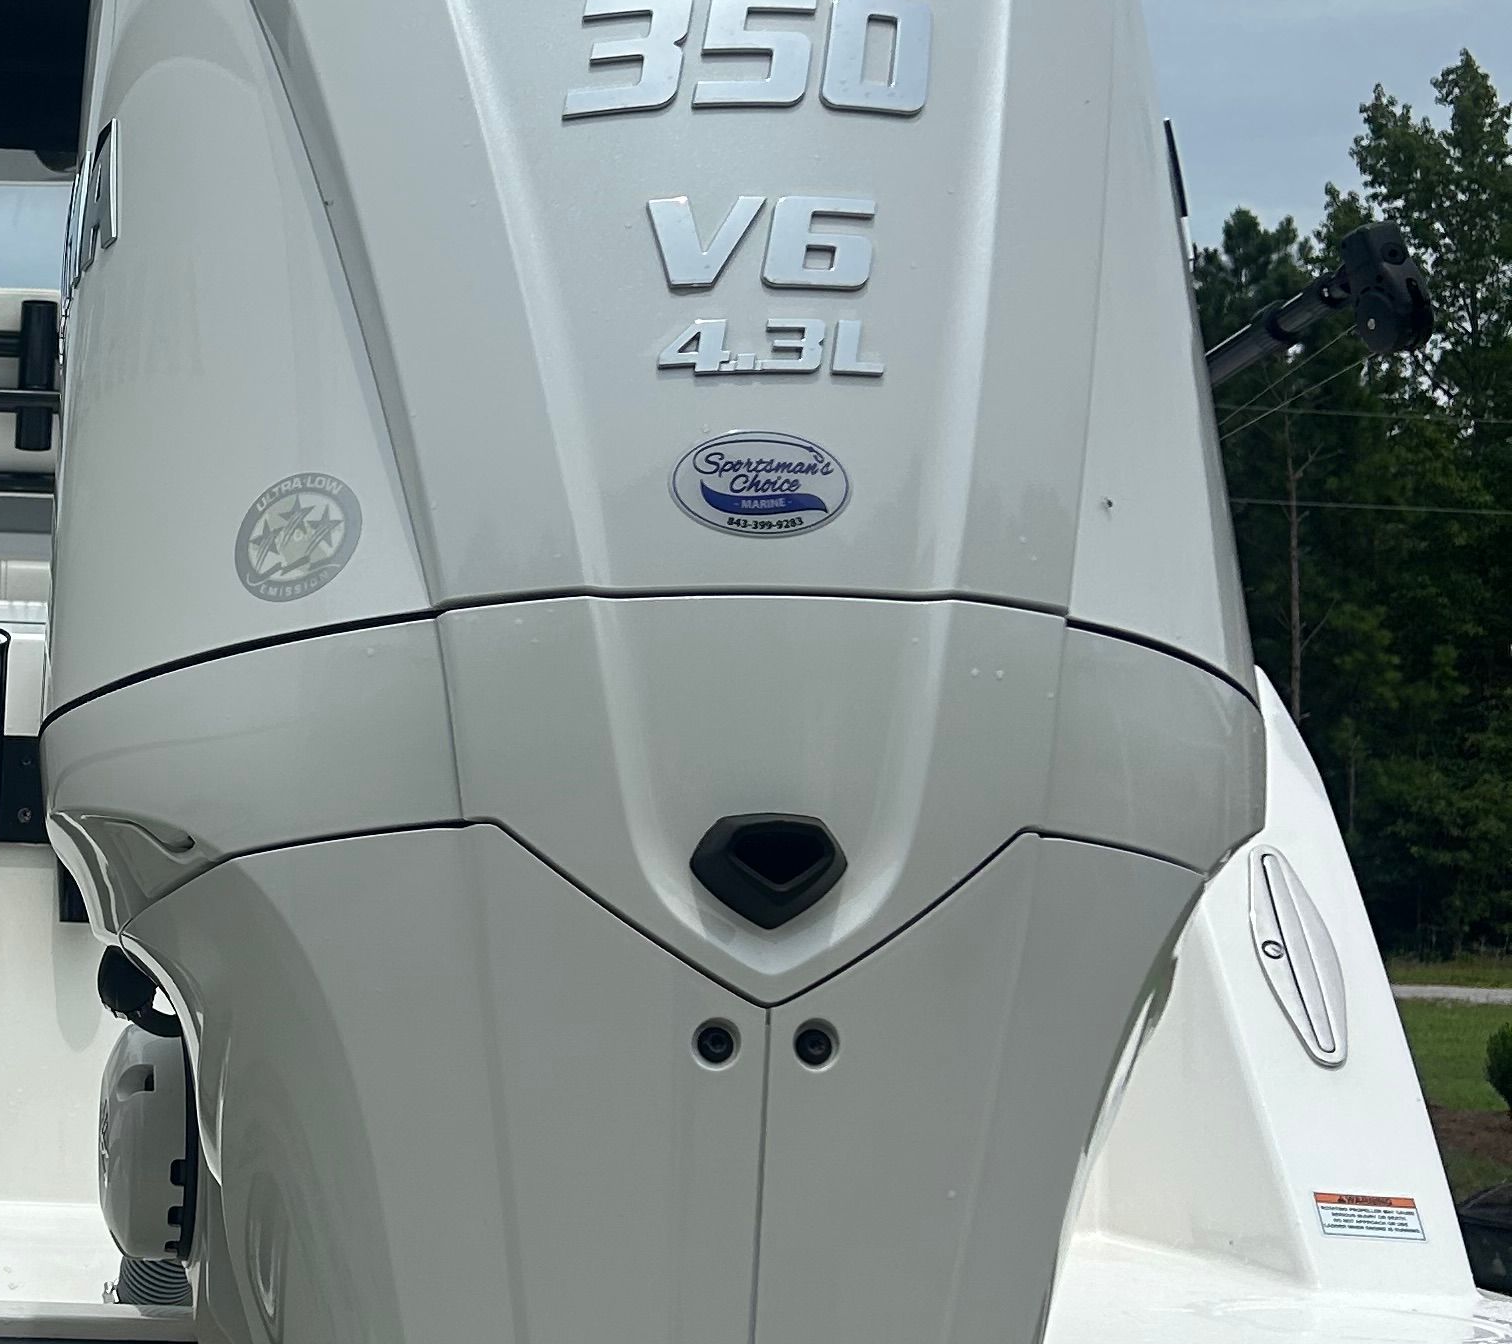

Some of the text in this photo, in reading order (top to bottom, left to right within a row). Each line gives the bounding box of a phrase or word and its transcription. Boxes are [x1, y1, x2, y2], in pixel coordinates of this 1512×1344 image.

[646, 196, 877, 291] V6
[656, 318, 885, 377] 4.3L
[694, 448, 834, 477] Sportsman's
[256, 475, 344, 512] ULTRA LOW
[729, 474, 801, 494] Choice
[741, 498, 786, 508] MARINE
[727, 516, 804, 530] 843-399-9283
